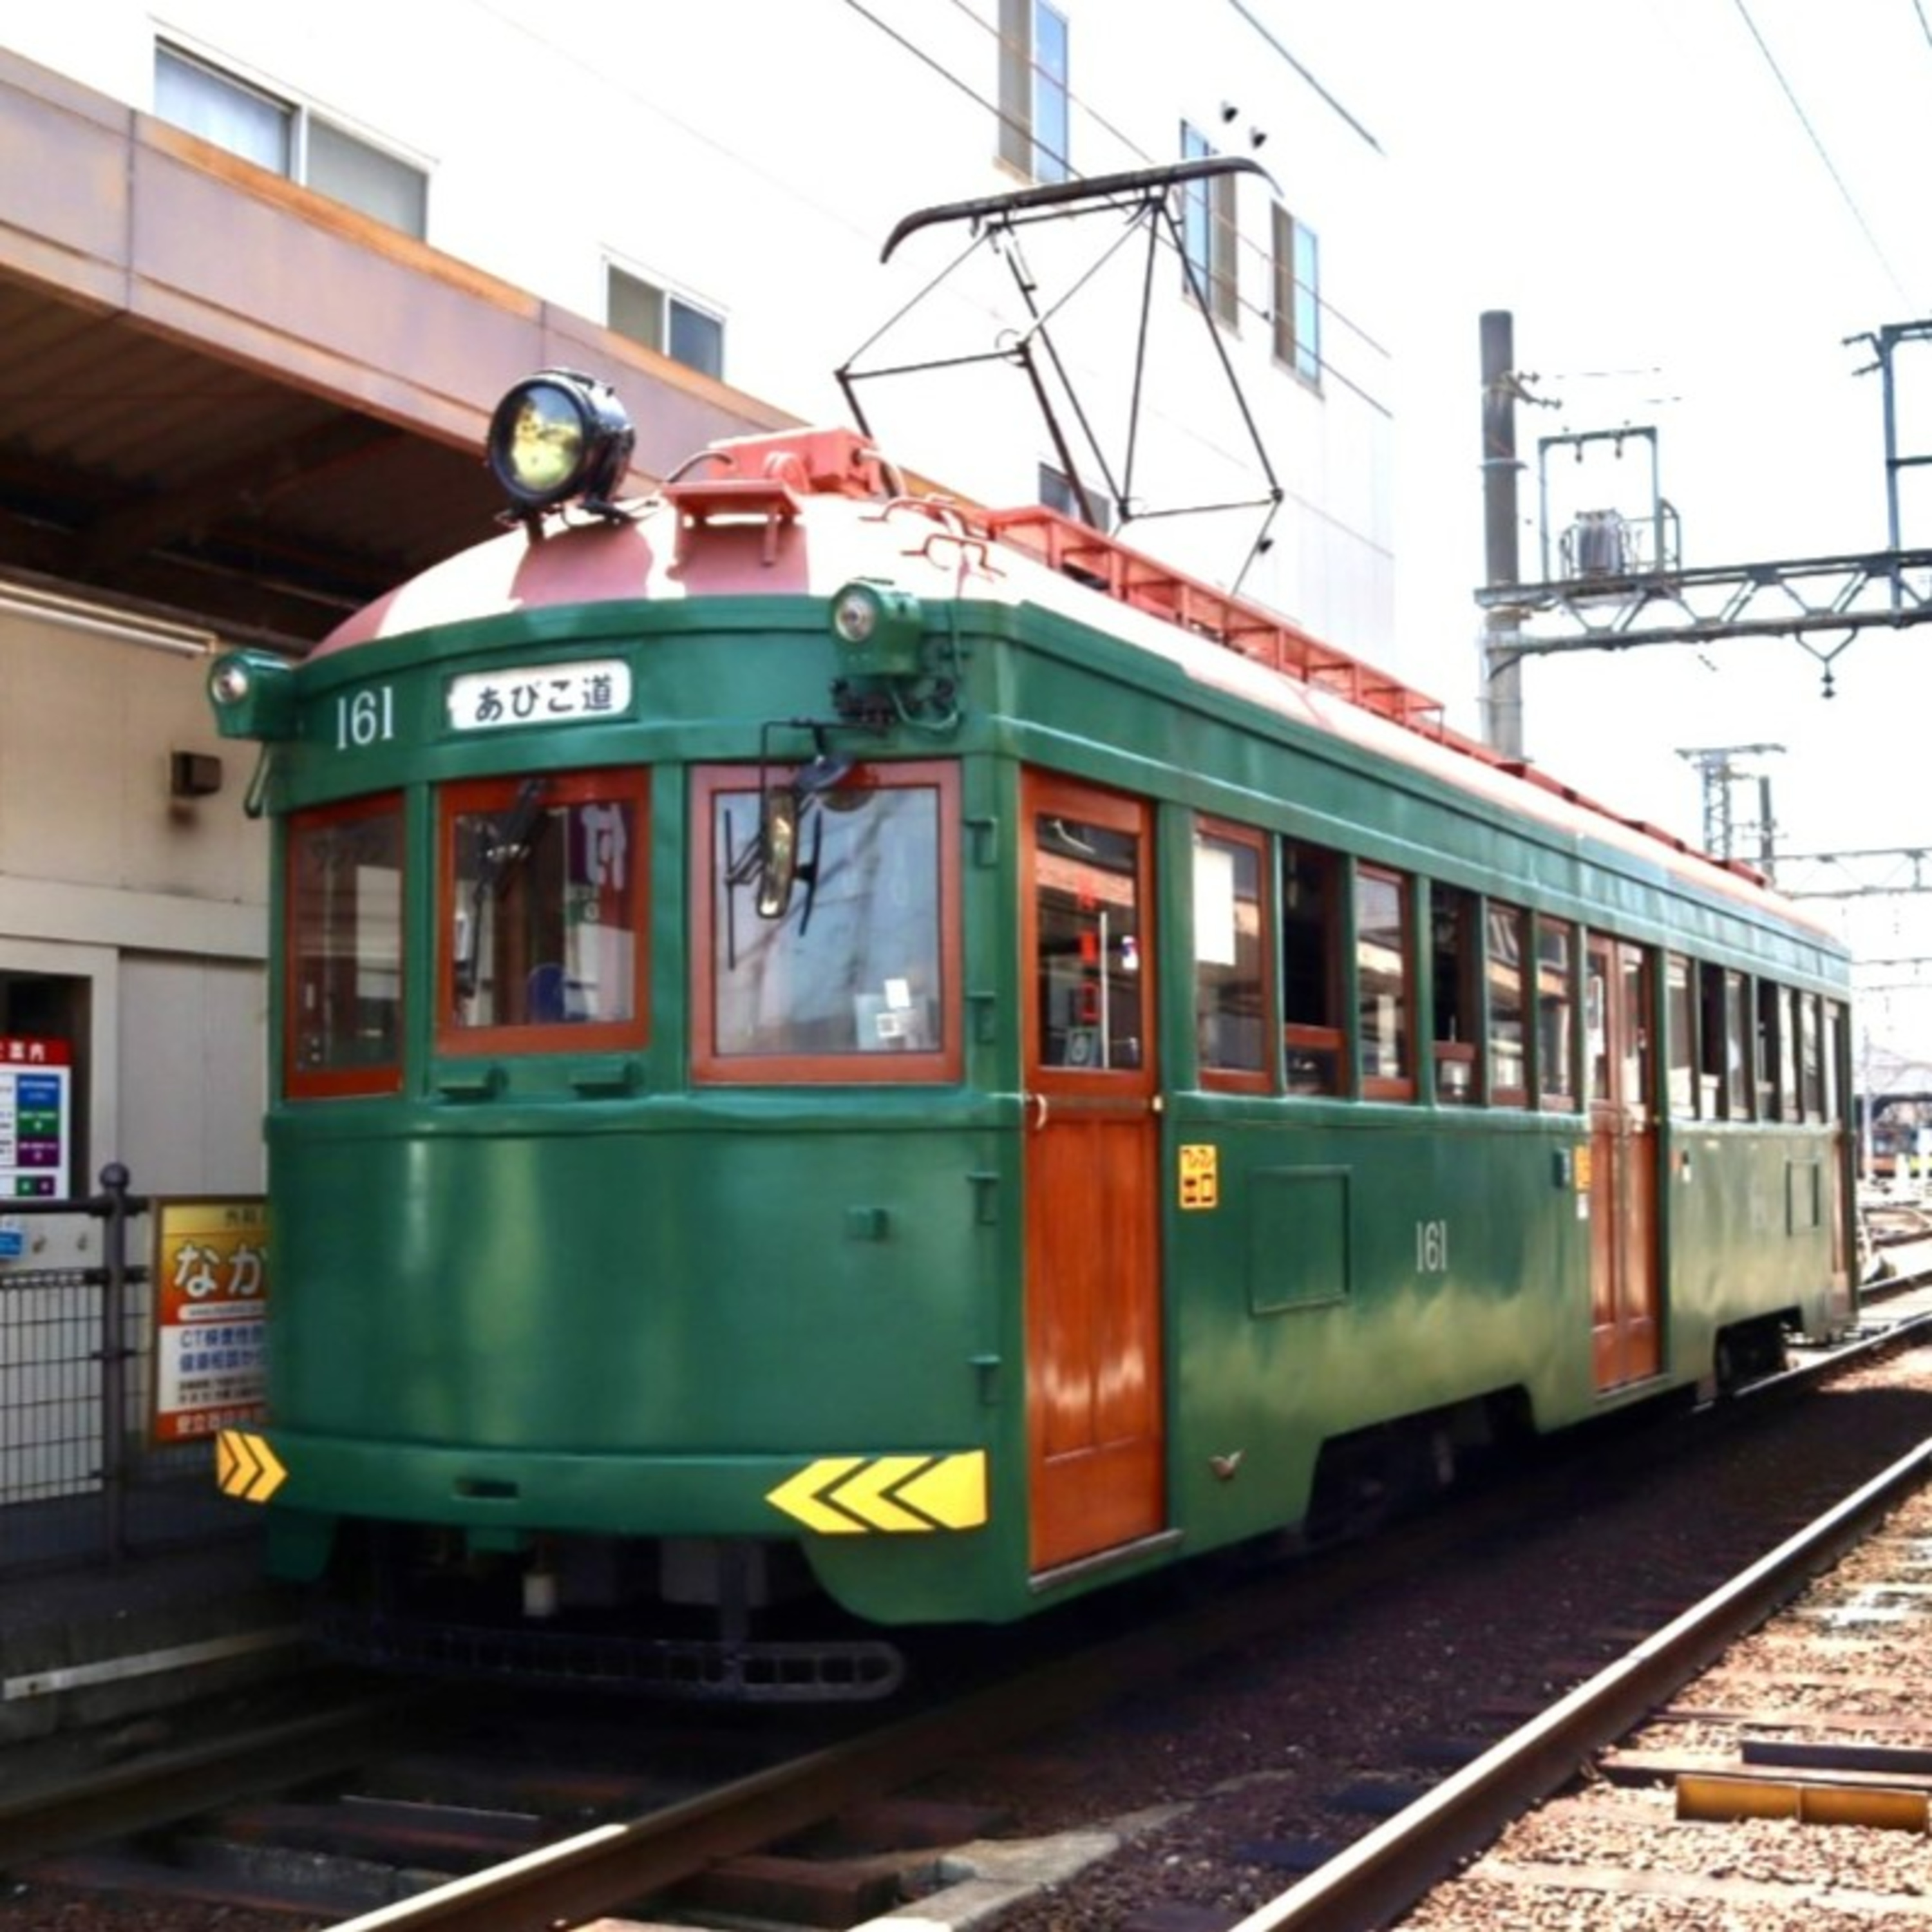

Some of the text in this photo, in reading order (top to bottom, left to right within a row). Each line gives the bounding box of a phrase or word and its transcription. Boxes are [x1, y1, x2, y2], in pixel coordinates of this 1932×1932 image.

[337, 685, 394, 750] 161
[475, 673, 613, 723] あびこ道
[1416, 1220, 1448, 1273] 161
